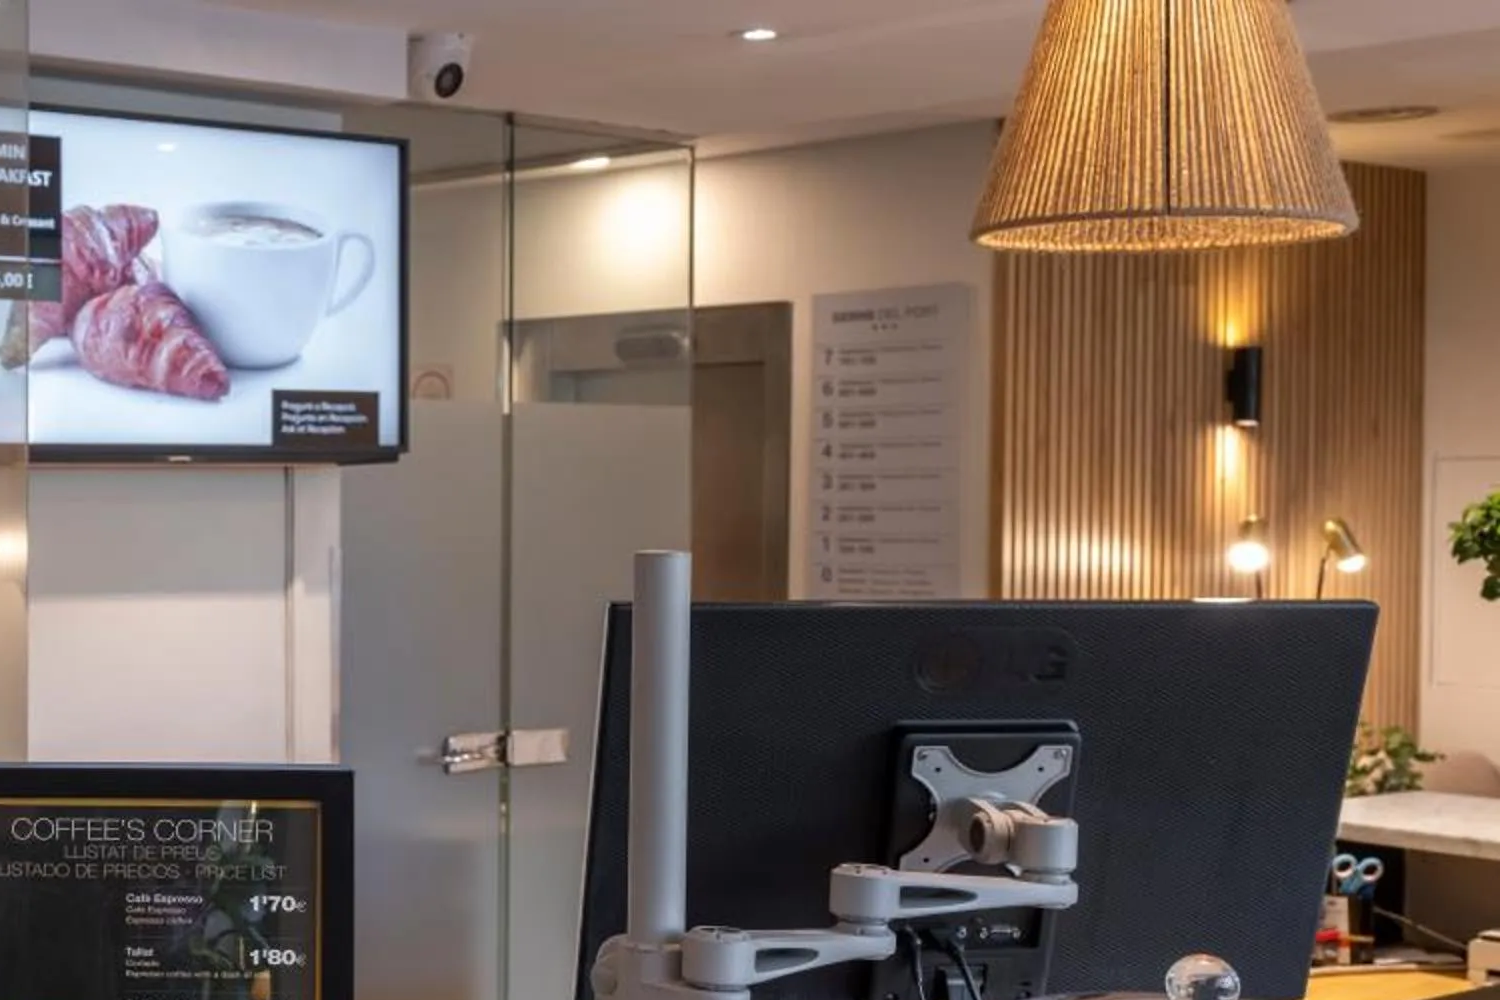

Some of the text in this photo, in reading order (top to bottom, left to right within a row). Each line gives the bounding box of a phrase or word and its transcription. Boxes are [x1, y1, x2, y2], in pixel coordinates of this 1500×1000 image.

[10, 817, 273, 843] COFFEE'S CORNER
[132, 846, 159, 861] DE
[75, 864, 98, 879] DE
[103, 864, 181, 879] PRECIOS
[195, 865, 247, 880] PRICE
[251, 865, 287, 880] LIST
